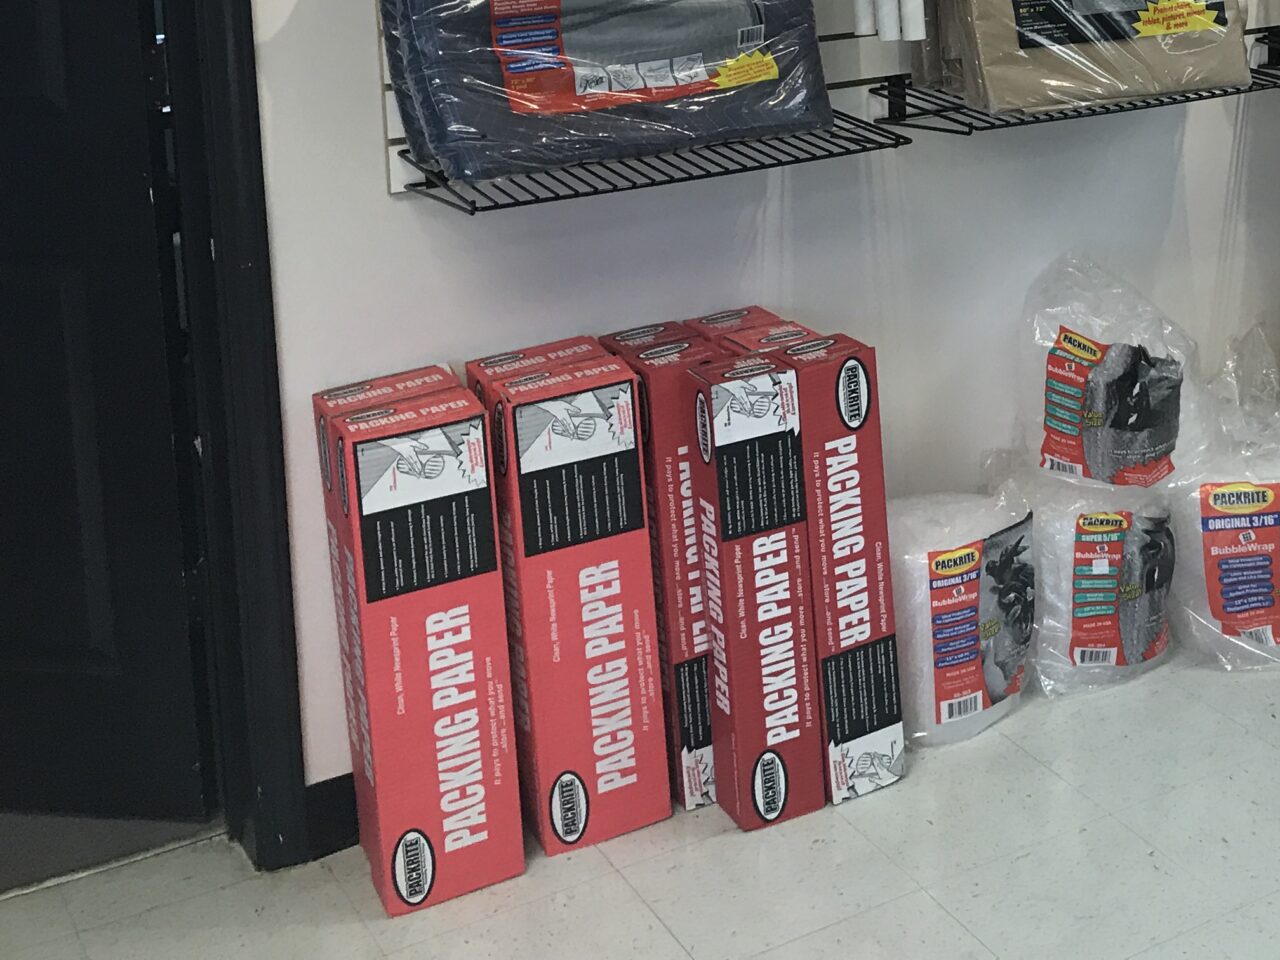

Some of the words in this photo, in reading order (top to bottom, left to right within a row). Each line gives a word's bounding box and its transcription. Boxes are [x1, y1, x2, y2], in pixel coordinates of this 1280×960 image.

[484, 355, 547, 376] PACKING
[548, 343, 593, 360] PAPER
[507, 373, 573, 395] PACKING
[574, 363, 621, 379] PAPER
[326, 386, 393, 408] PACKING
[395, 373, 443, 391] PAPER
[347, 410, 417, 433] PACKING
[420, 398, 469, 416] PAPER
[846, 363, 862, 423] PACKRITE
[815, 488, 824, 518] protect
[824, 435, 865, 560] PACKING
[1081, 516, 1125, 528] PACKRITE
[1208, 516, 1250, 531] ORIGINAL
[1251, 514, 1279, 528] 3/16"
[1213, 489, 1269, 506] PACKRITE
[818, 518, 826, 538] what
[1075, 551, 1122, 561] BubbleWrap
[1210, 542, 1276, 556] BubbleWrap
[699, 497, 724, 625] PACKING
[752, 531, 792, 622] PAPER
[934, 550, 977, 571] PACKRITE
[578, 560, 626, 659] PAPER
[834, 559, 871, 649] PAPER
[932, 591, 978, 608] BubbleWrap
[425, 603, 477, 711] PAPER
[711, 624, 731, 716] PAPER
[758, 621, 801, 746] PACKING
[586, 657, 638, 794] PACKING
[433, 708, 488, 854] PACKING
[559, 777, 581, 838] PACKRITE
[760, 756, 781, 816] PACKRITE
[403, 836, 426, 899] PACKRITE
